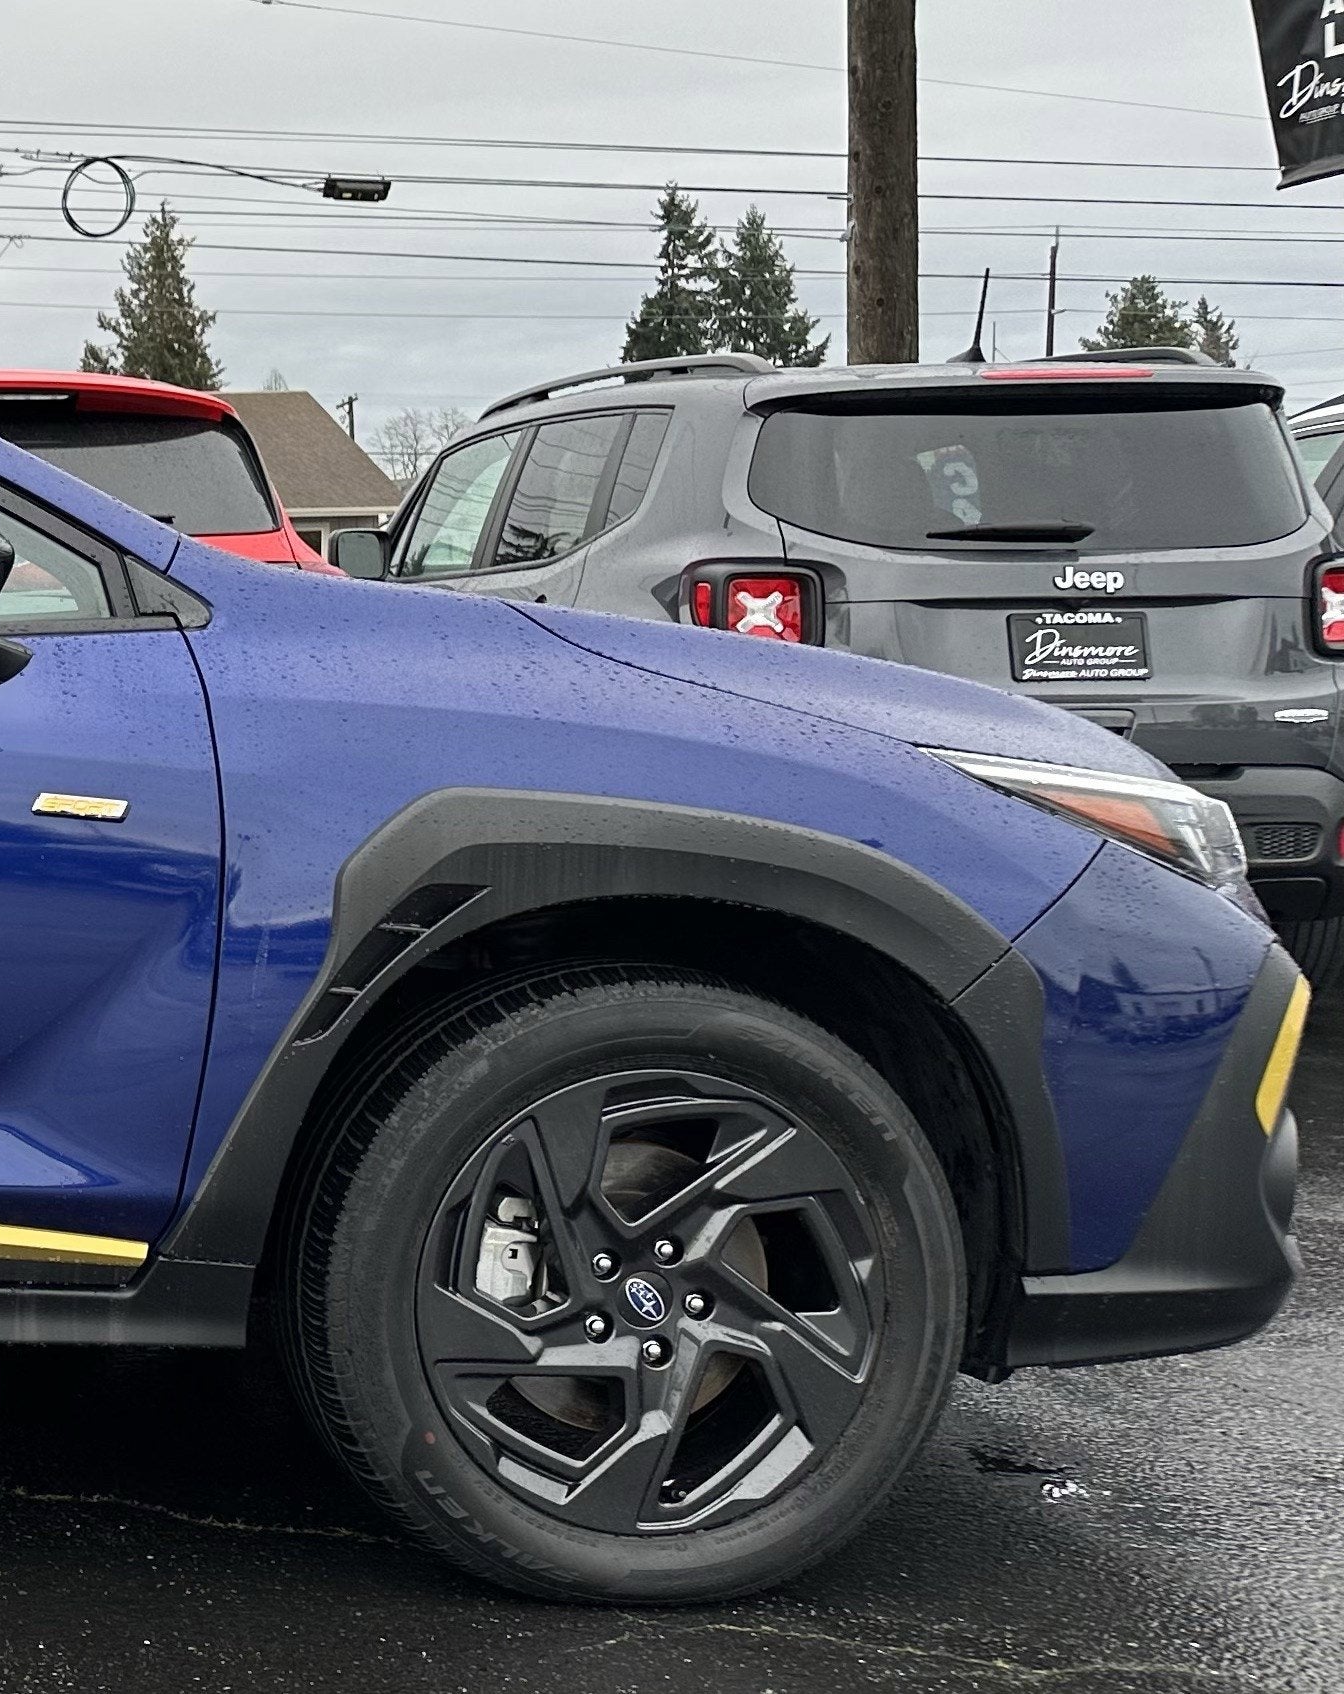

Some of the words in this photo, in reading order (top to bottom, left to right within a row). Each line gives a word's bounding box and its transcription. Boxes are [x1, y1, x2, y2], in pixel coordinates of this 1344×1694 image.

[1276, 60, 1344, 119] Dins
[1053, 566, 1124, 594] Jeep
[1024, 628, 1140, 665] Dinsmore
[1059, 658, 1085, 666] AUTO
[1086, 657, 1120, 666] GROUP
[1078, 668, 1109, 678] AUTO
[1109, 668, 1149, 678] GROUP
